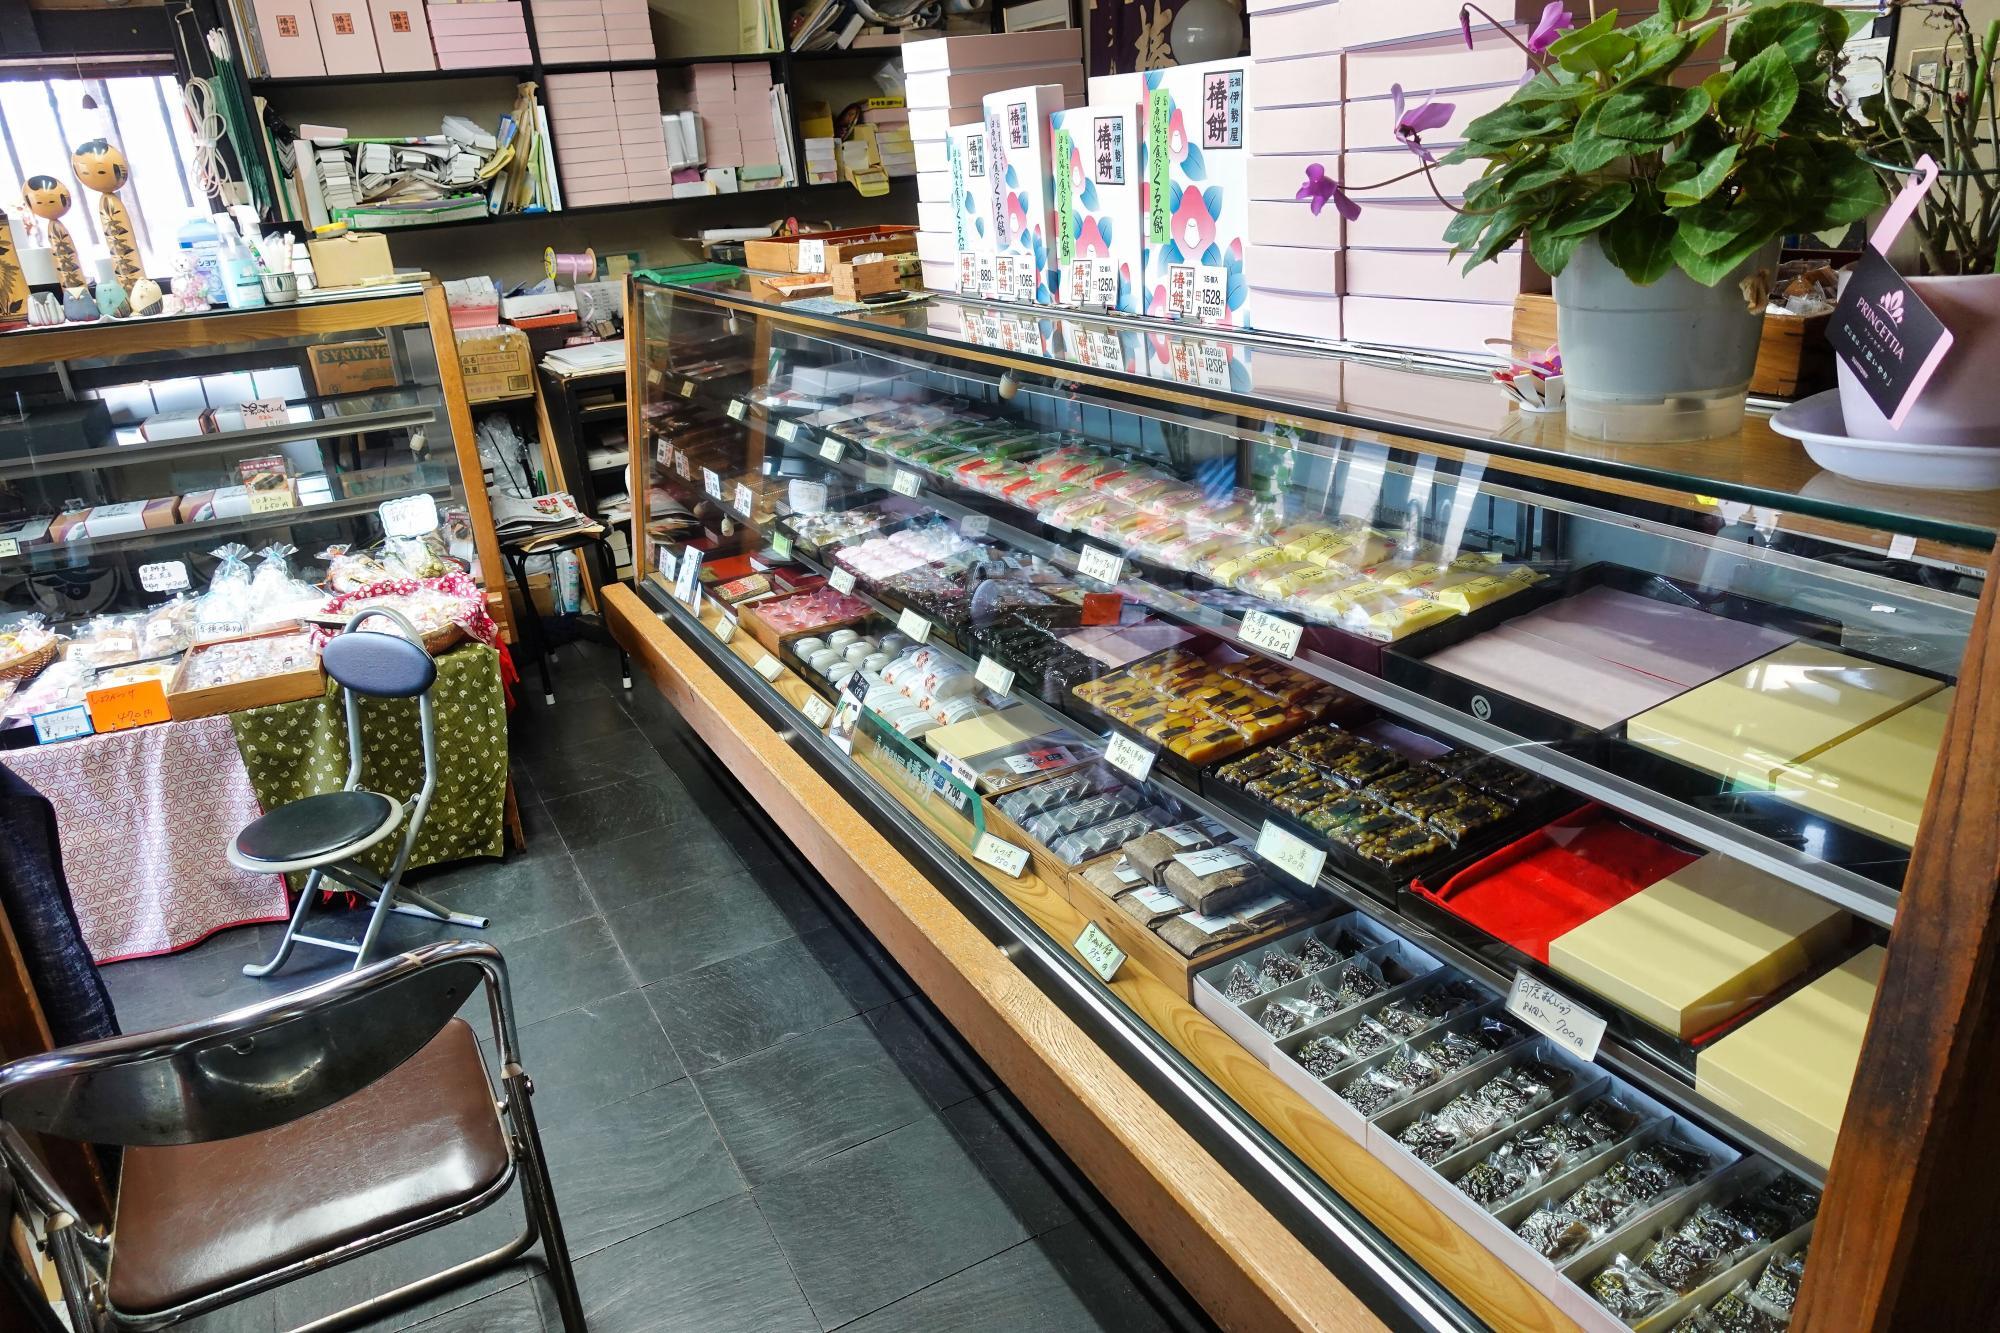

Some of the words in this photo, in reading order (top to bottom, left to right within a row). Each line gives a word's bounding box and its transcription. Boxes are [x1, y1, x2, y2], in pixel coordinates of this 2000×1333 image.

[1010, 107, 1021, 145] 椿餅
[1206, 77, 1228, 143] 椿餅
[1096, 123, 1113, 179] 椿餅
[1073, 264, 1085, 297] 椿餅
[1172, 271, 1185, 308] 椿餅
[1202, 289, 1225, 306] 1528円
[1856, 296, 1905, 360] PRINCETTIA
[1556, 1019, 1584, 1047] 700円
